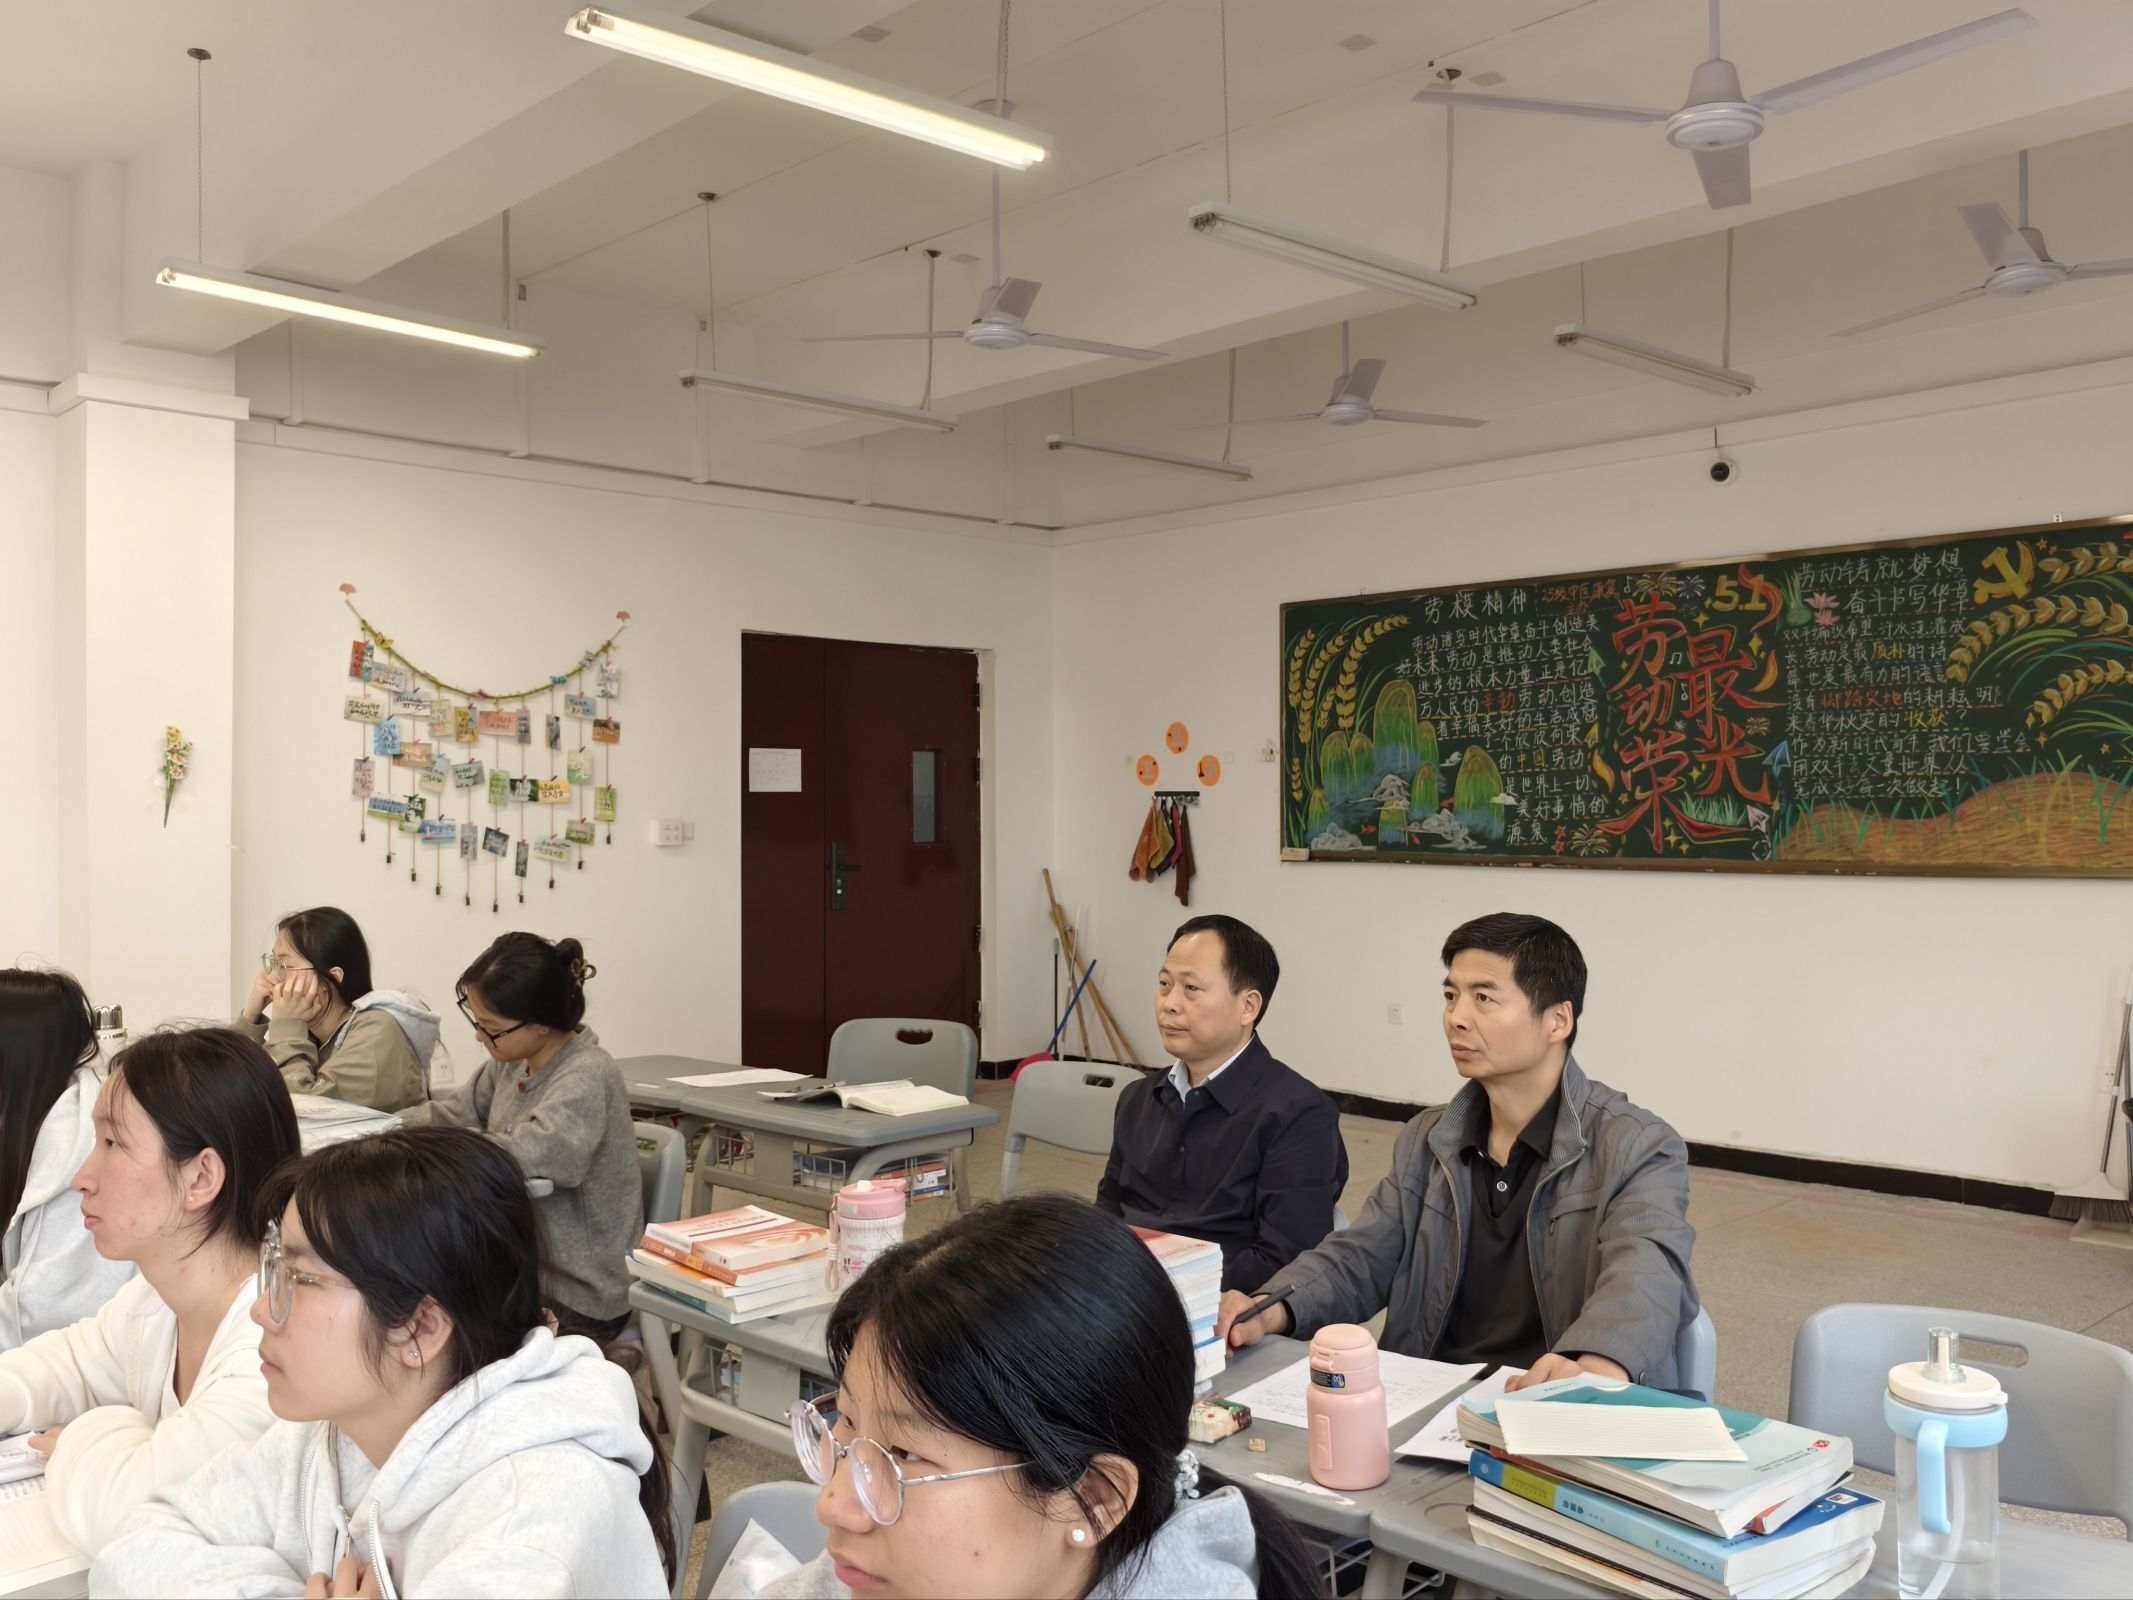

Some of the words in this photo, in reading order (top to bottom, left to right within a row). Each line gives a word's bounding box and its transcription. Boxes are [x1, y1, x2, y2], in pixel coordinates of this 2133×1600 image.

[1799, 547, 1965, 588] 劳动铸就梦想
[1424, 589, 1527, 625] 劳模精神
[1844, 577, 1970, 616] 奋斗书写华章
